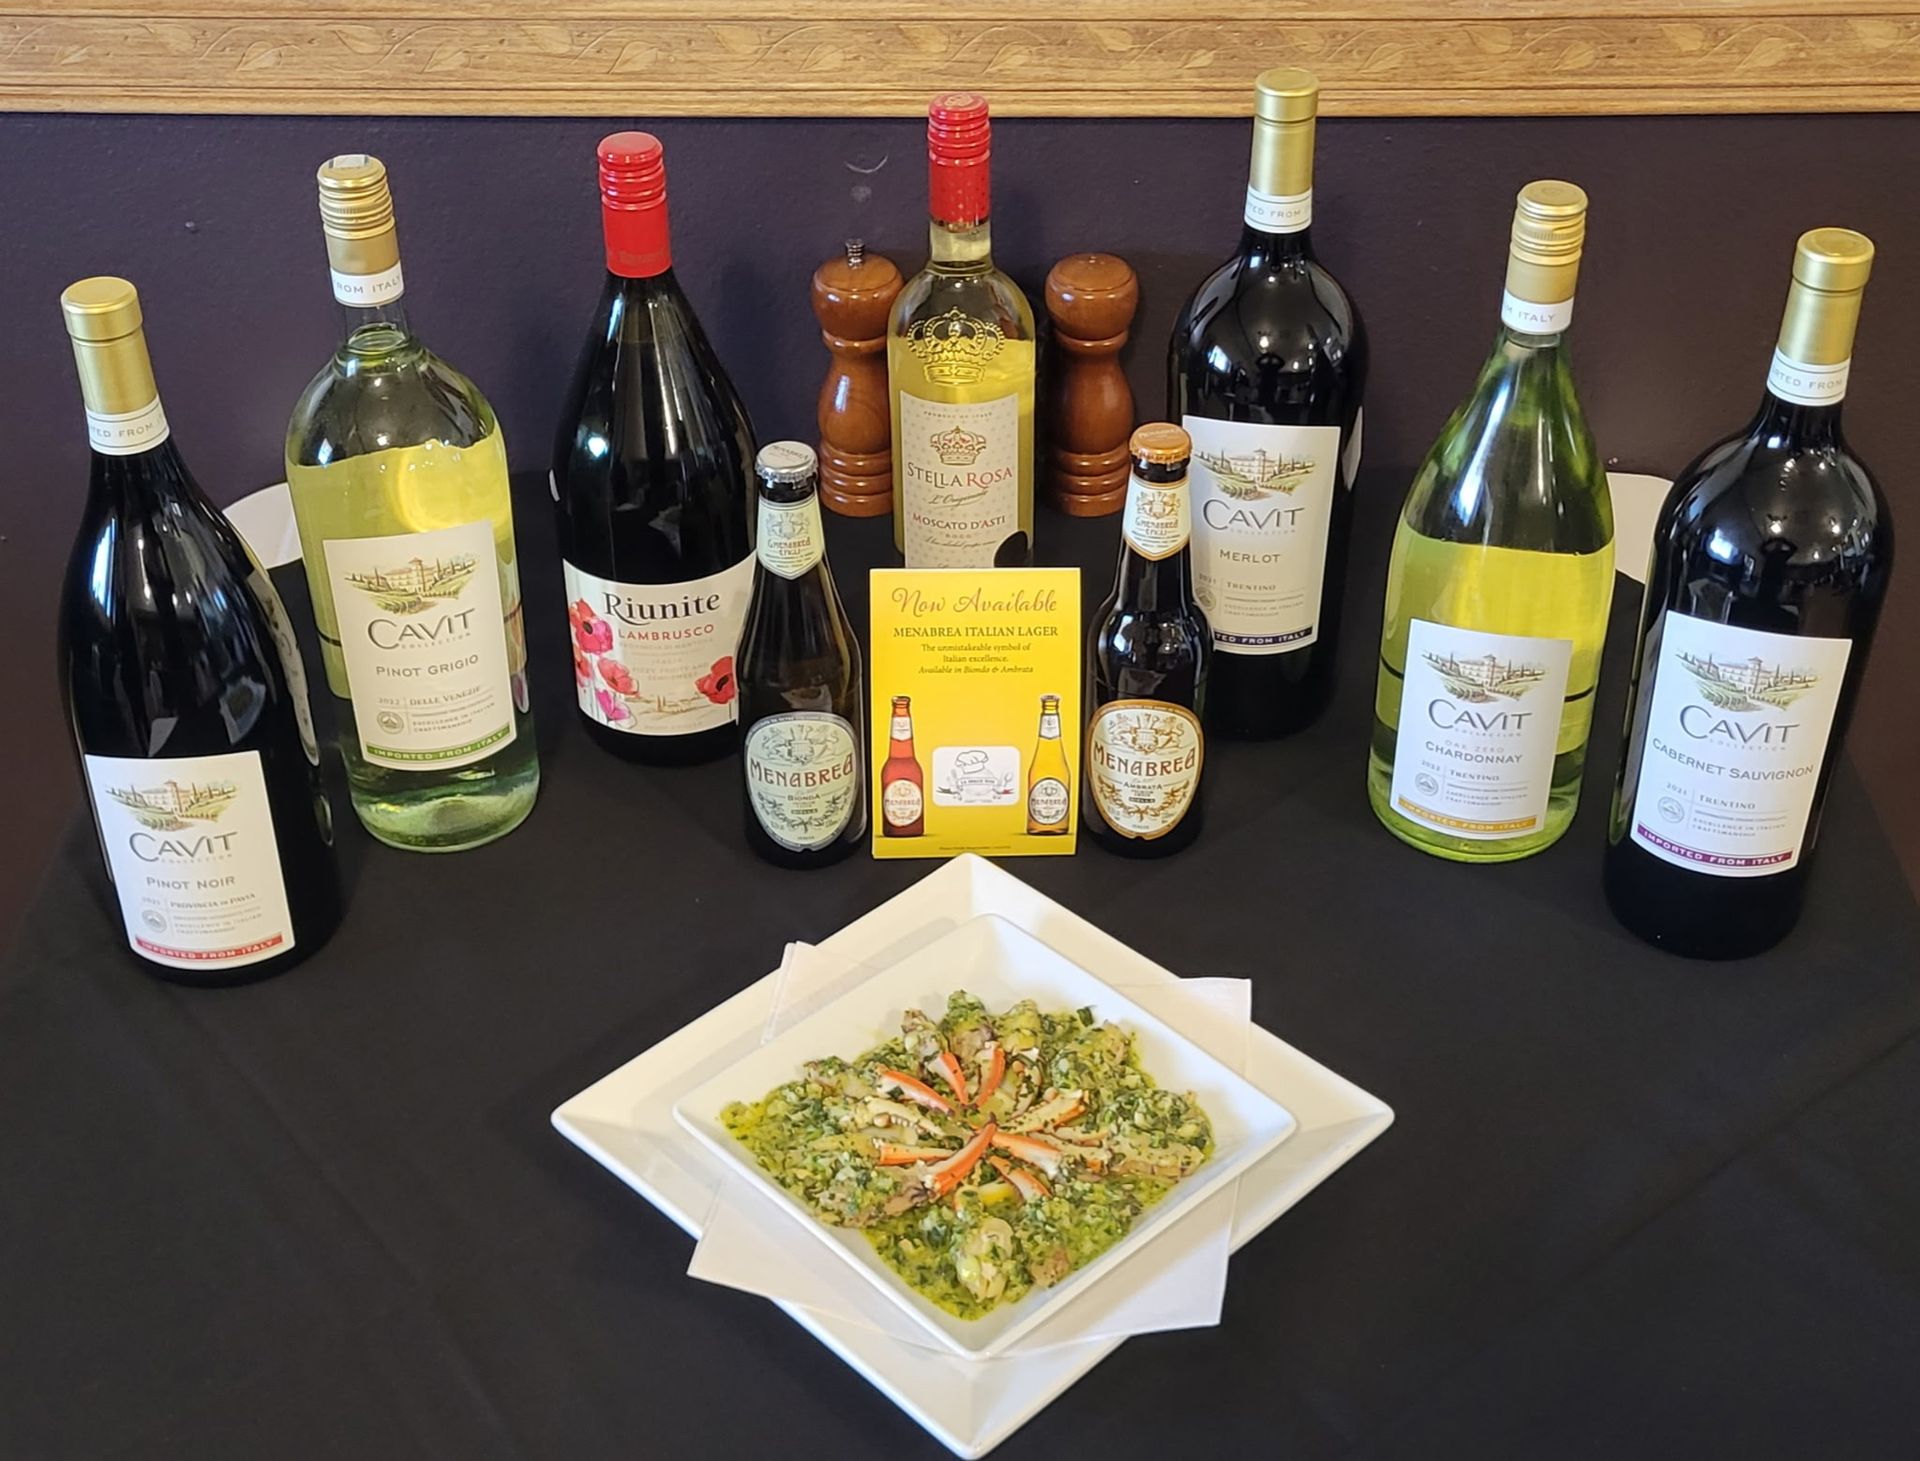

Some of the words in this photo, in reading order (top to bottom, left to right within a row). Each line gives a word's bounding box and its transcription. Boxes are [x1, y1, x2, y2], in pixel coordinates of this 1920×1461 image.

[1270, 210, 1301, 218] FROM
[1519, 312, 1556, 323] ITALY
[118, 423, 153, 437] FROM
[907, 462, 963, 488] STELLA
[967, 467, 1012, 489] ROSA
[913, 513, 967, 530] MOSCATO
[971, 515, 1006, 530] D'ASTI
[1203, 499, 1305, 530] CAVIT
[1220, 550, 1281, 563] MERLOT
[1227, 582, 1276, 590] TRENTINO
[603, 592, 721, 626] Riunite
[891, 587, 946, 618] Now
[953, 587, 1057, 613] Available
[367, 608, 475, 650] CAVIT
[618, 624, 714, 640] LAMBRUSCO
[893, 627, 962, 637] MENABREA
[965, 627, 1015, 637] ITALIAN
[1018, 626, 1058, 636] LAGER
[1279, 631, 1305, 641] ITALY
[993, 643, 1021, 652] symbol
[1023, 643, 1031, 651] of
[376, 666, 422, 677] PINOT
[428, 655, 478, 675] GRIGIO
[1428, 699, 1532, 730] CAVIT
[1680, 705, 1800, 743] CAVIT
[374, 750, 433, 759] IMPORTED
[439, 746, 472, 758] FROM
[477, 732, 504, 749] ITALY
[1426, 741, 1523, 764] CHARDONNAY
[1094, 740, 1195, 776] MENABREA
[1653, 738, 1726, 776] CABERNET
[1729, 765, 1814, 781] SAUVIGNON
[750, 753, 854, 787] MENABREA
[1450, 770, 1500, 781] TRENTINO
[1699, 795, 1756, 809] TRENTINO
[1462, 822, 1496, 830] FROM
[130, 832, 238, 862] CAVIT
[1643, 831, 1703, 860] IMPORTED
[1710, 857, 1746, 865] FROM
[1752, 856, 1783, 865] ITALY
[146, 877, 190, 890] PINOT
[197, 876, 235, 889] NOIR
[202, 950, 235, 958] FROM
[242, 941, 273, 954] ITALY
